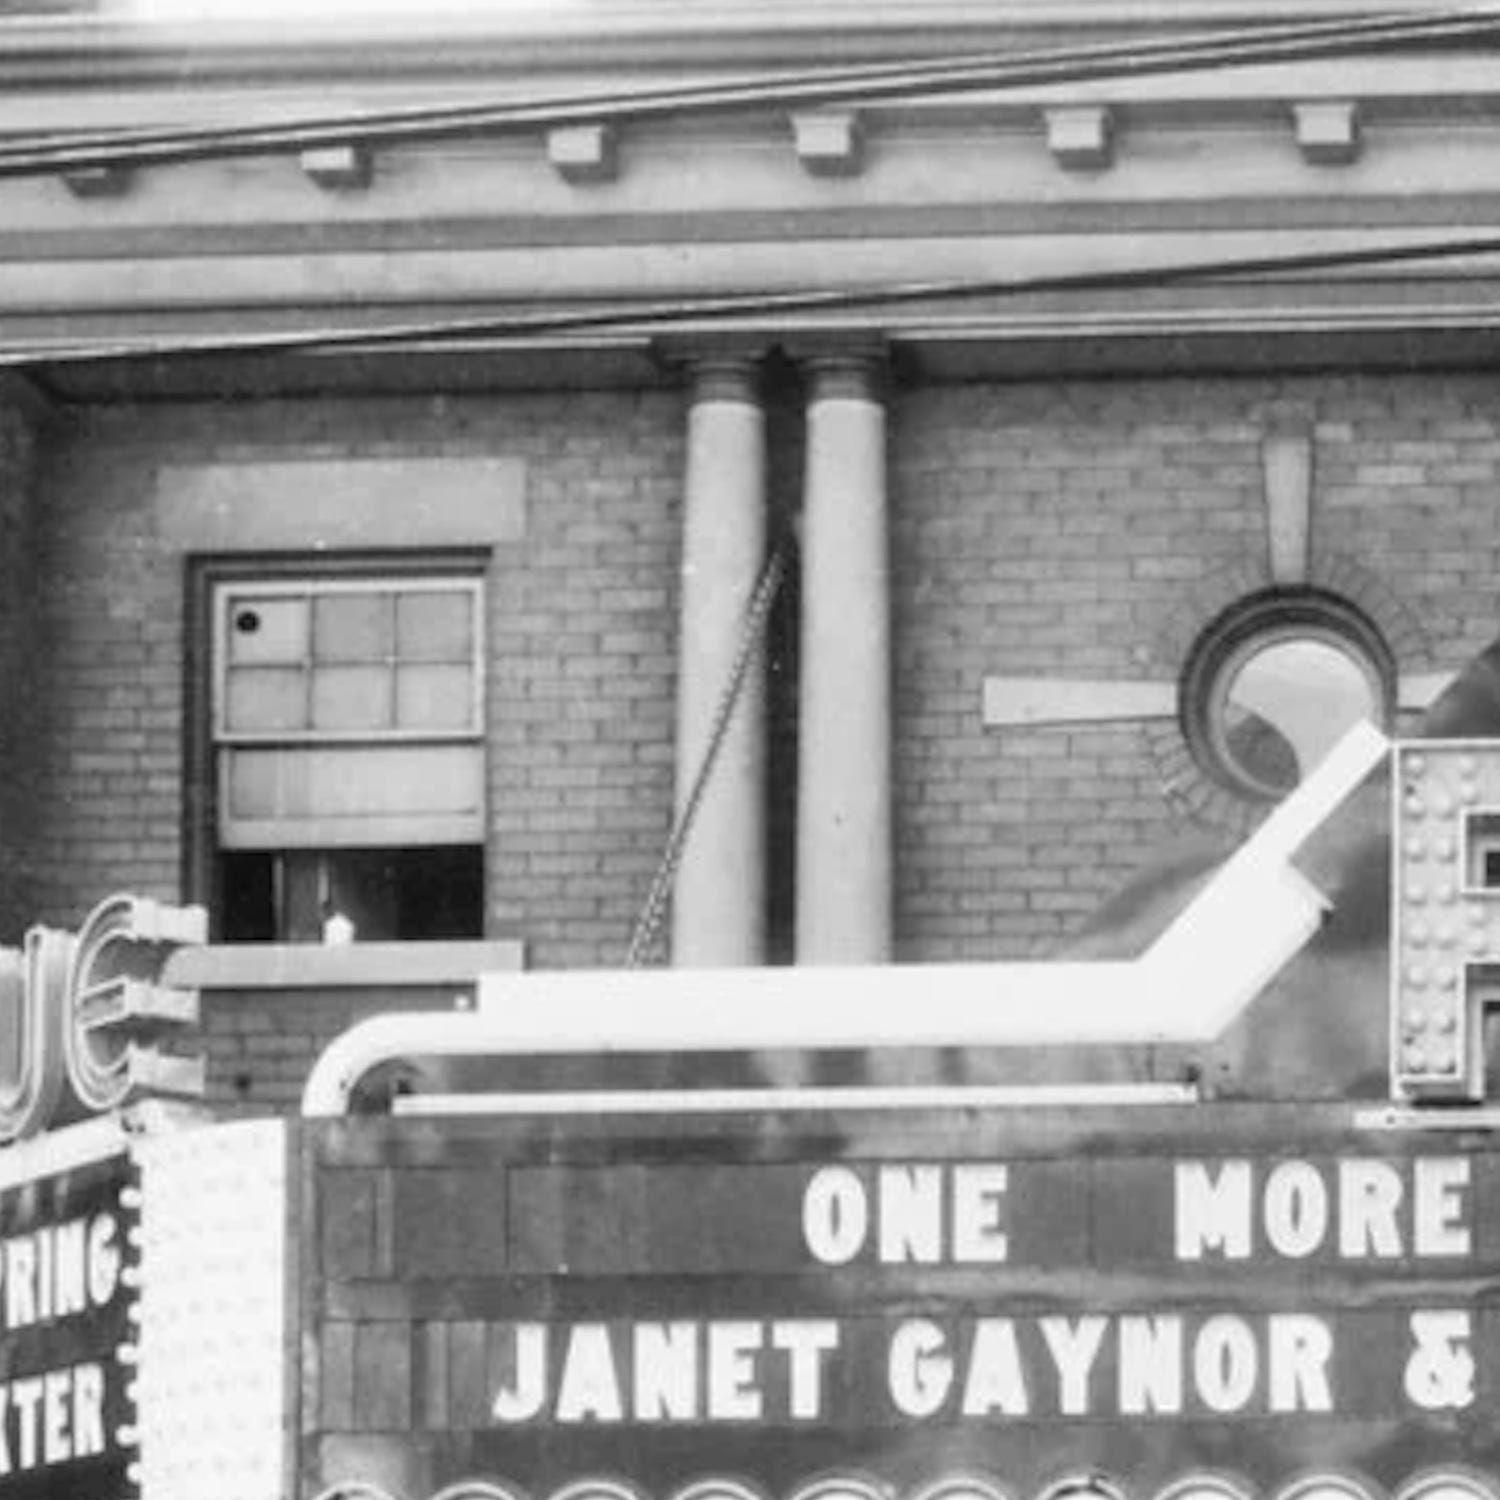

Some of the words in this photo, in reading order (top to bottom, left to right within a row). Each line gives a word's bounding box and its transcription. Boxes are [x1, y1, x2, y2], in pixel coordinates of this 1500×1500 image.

[802, 1164, 1008, 1265] ONE
[1174, 1158, 1471, 1261] MORE
[491, 1319, 839, 1422] JANET
[888, 1312, 1334, 1418] GAYNOR
[1404, 1309, 1475, 1410] &
